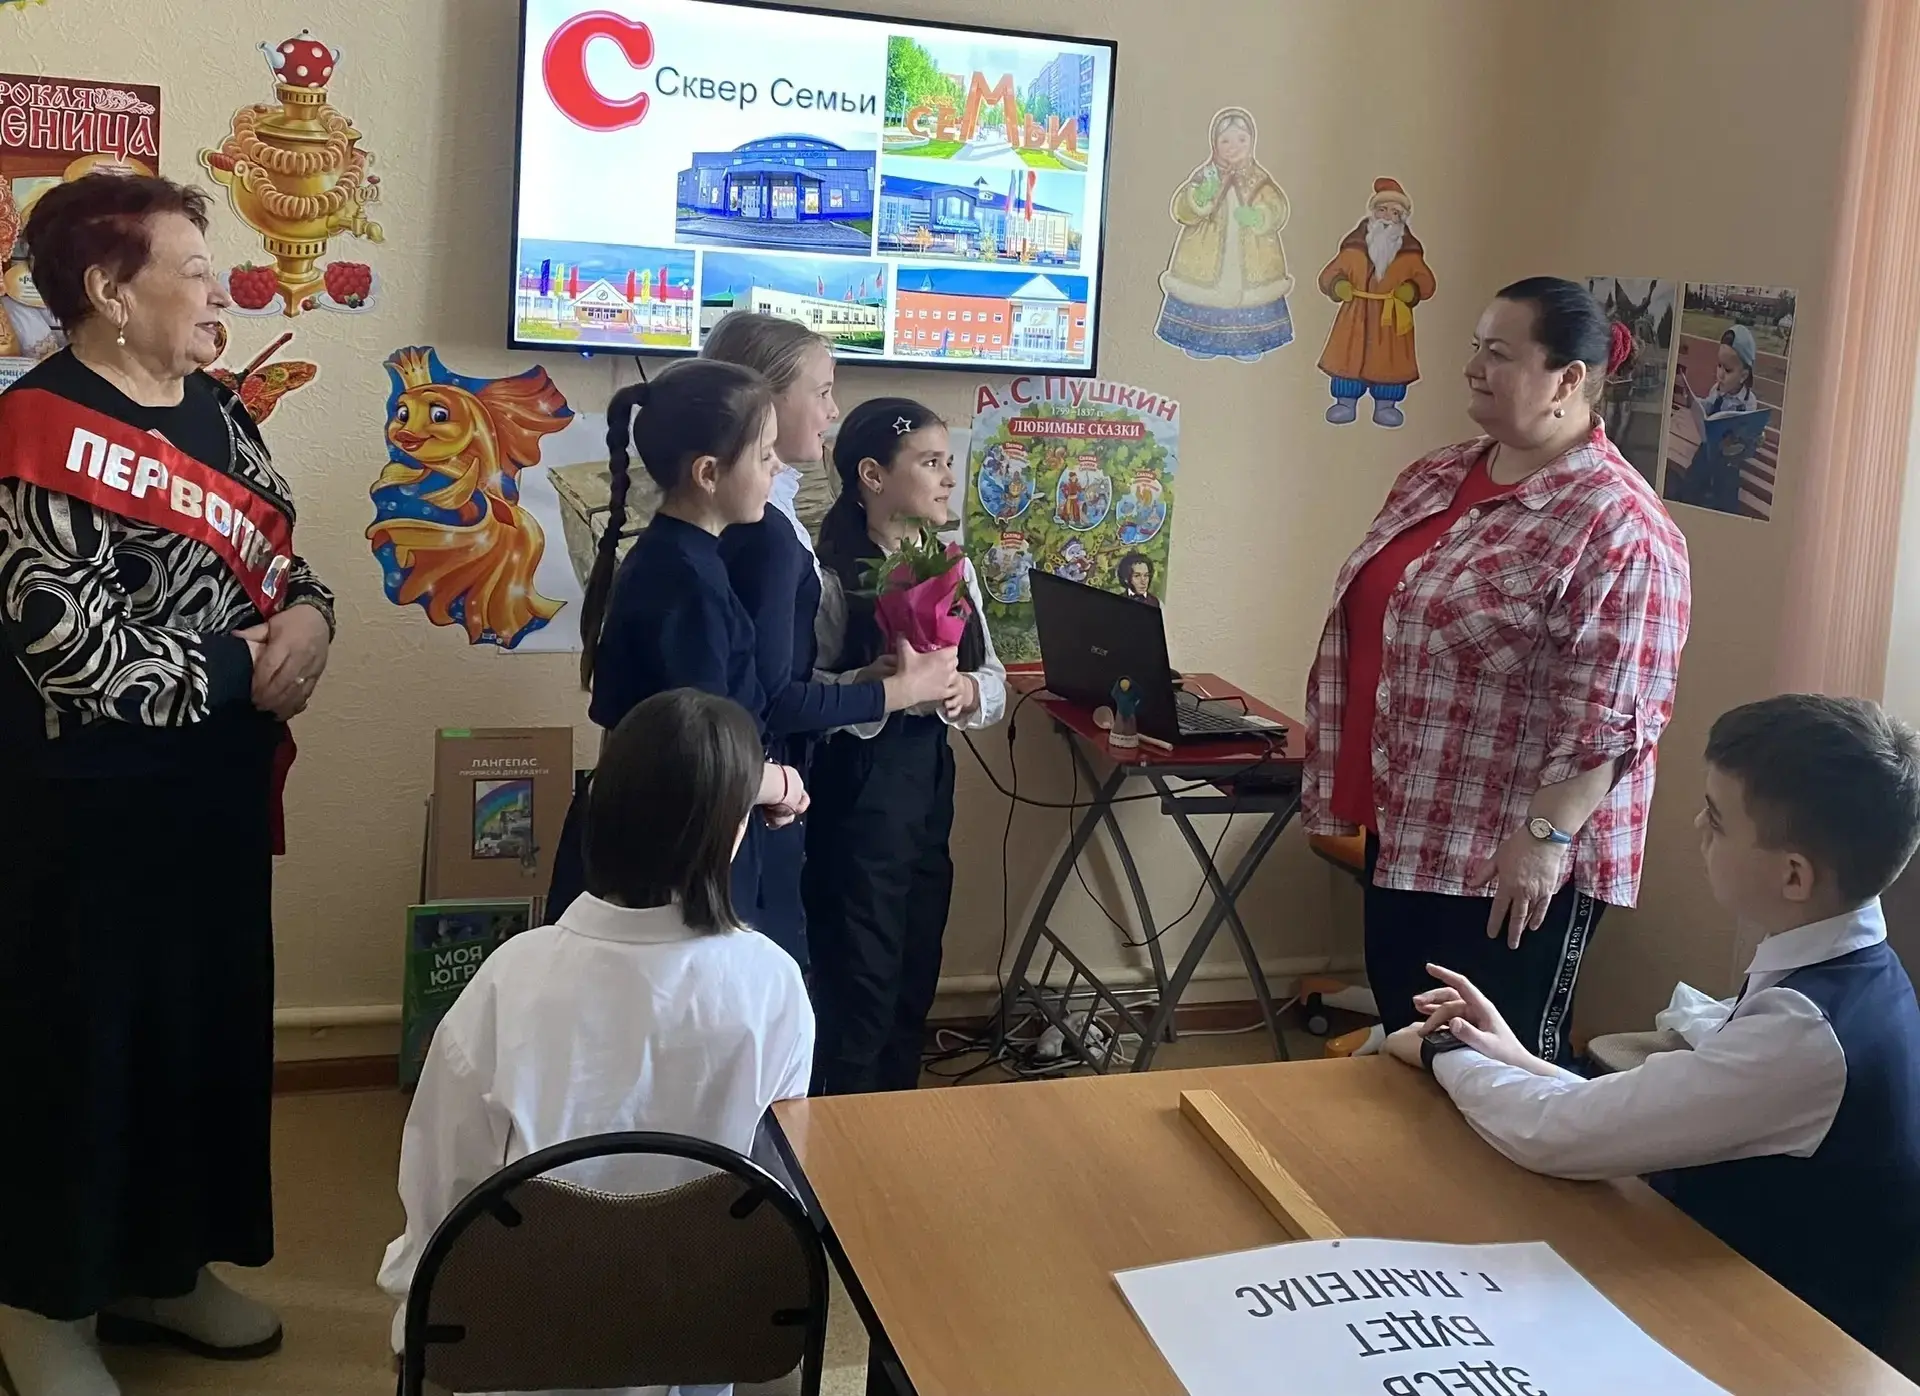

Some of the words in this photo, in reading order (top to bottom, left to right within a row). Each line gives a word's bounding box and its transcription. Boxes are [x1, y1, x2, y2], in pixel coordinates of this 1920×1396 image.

[655, 66, 758, 110] Сквер
[770, 77, 877, 116] Семьи
[0, 105, 158, 165] ЕНИЦА
[1013, 420, 1085, 435] ЛЮБИМЫЕ
[1088, 423, 1140, 437] СКАЗКИ
[471, 758, 538, 768] ЛАНГЕПАС
[430, 963, 478, 986] ЮГР
[434, 945, 483, 969] МОЯ
[1235, 1268, 1464, 1318] ЛАНГЕПАС
[1346, 1309, 1496, 1357] БУДЕТ
